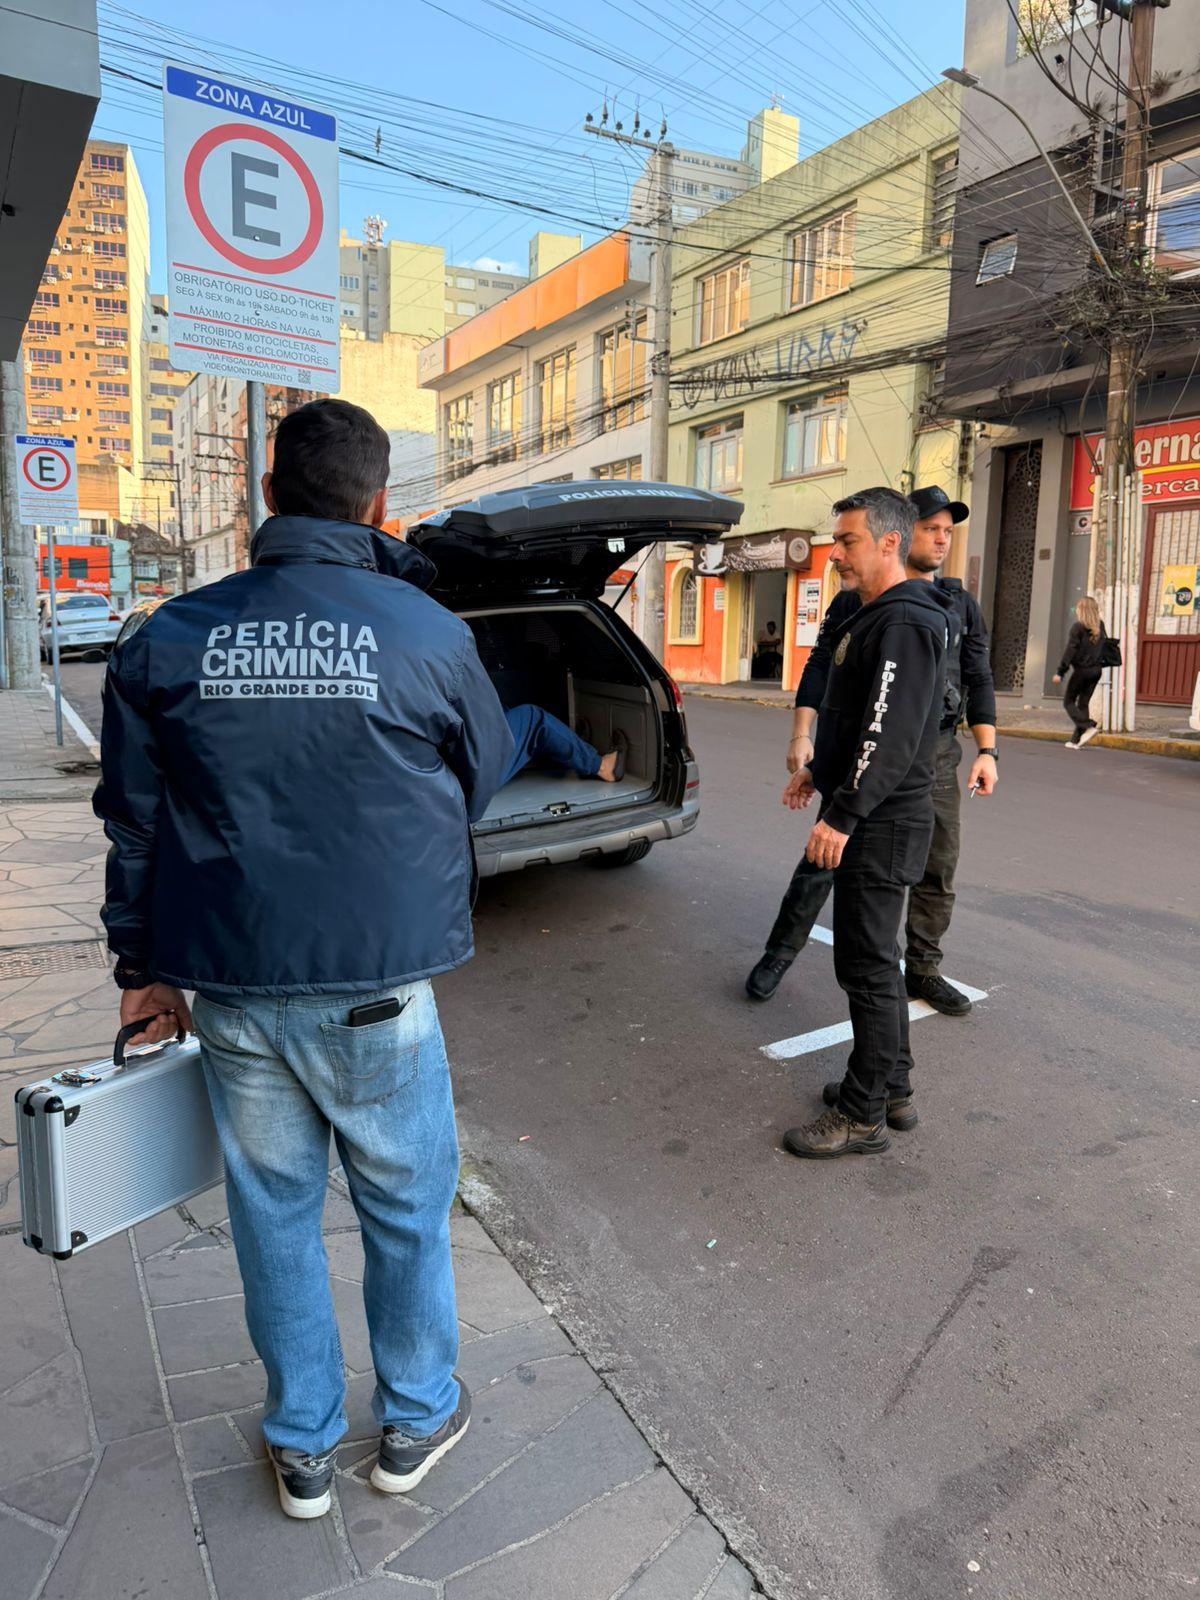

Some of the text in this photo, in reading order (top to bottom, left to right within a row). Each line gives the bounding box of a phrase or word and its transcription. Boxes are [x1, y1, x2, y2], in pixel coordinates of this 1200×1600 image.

[195, 79, 312, 131] ZONA AZUL
[231, 151, 281, 247] E
[174, 271, 335, 312] OBRIGATÓRIO USO DO TICKET
[175, 285, 195, 297] SEG
[205, 291, 223, 302] SEX
[224, 296, 234, 305] 9h
[300, 311, 309, 320] 9h
[322, 315, 335, 325] 13h
[189, 304, 322, 338] MÁXIMO 2 HORAS NA VAGA
[182, 332, 329, 367] MOTONETAS e CICLOMOTORES
[193, 322, 319, 355] PROIBIDO MOTOCICLETAS,
[203, 361, 293, 382] VIDEOMONITORAMENTO
[207, 352, 287, 373] VIA FISCALIZADA POR
[25, 437, 66, 447] ZONA AZUL
[38, 456, 57, 483] E
[637, 488, 684, 498] CIVIL
[206, 612, 379, 652] PERÍCIA
[201, 648, 379, 680] CRIMINAL
[204, 683, 374, 698] RIO GRANDE DO SUL
[853, 740, 877, 790] CIVIL
